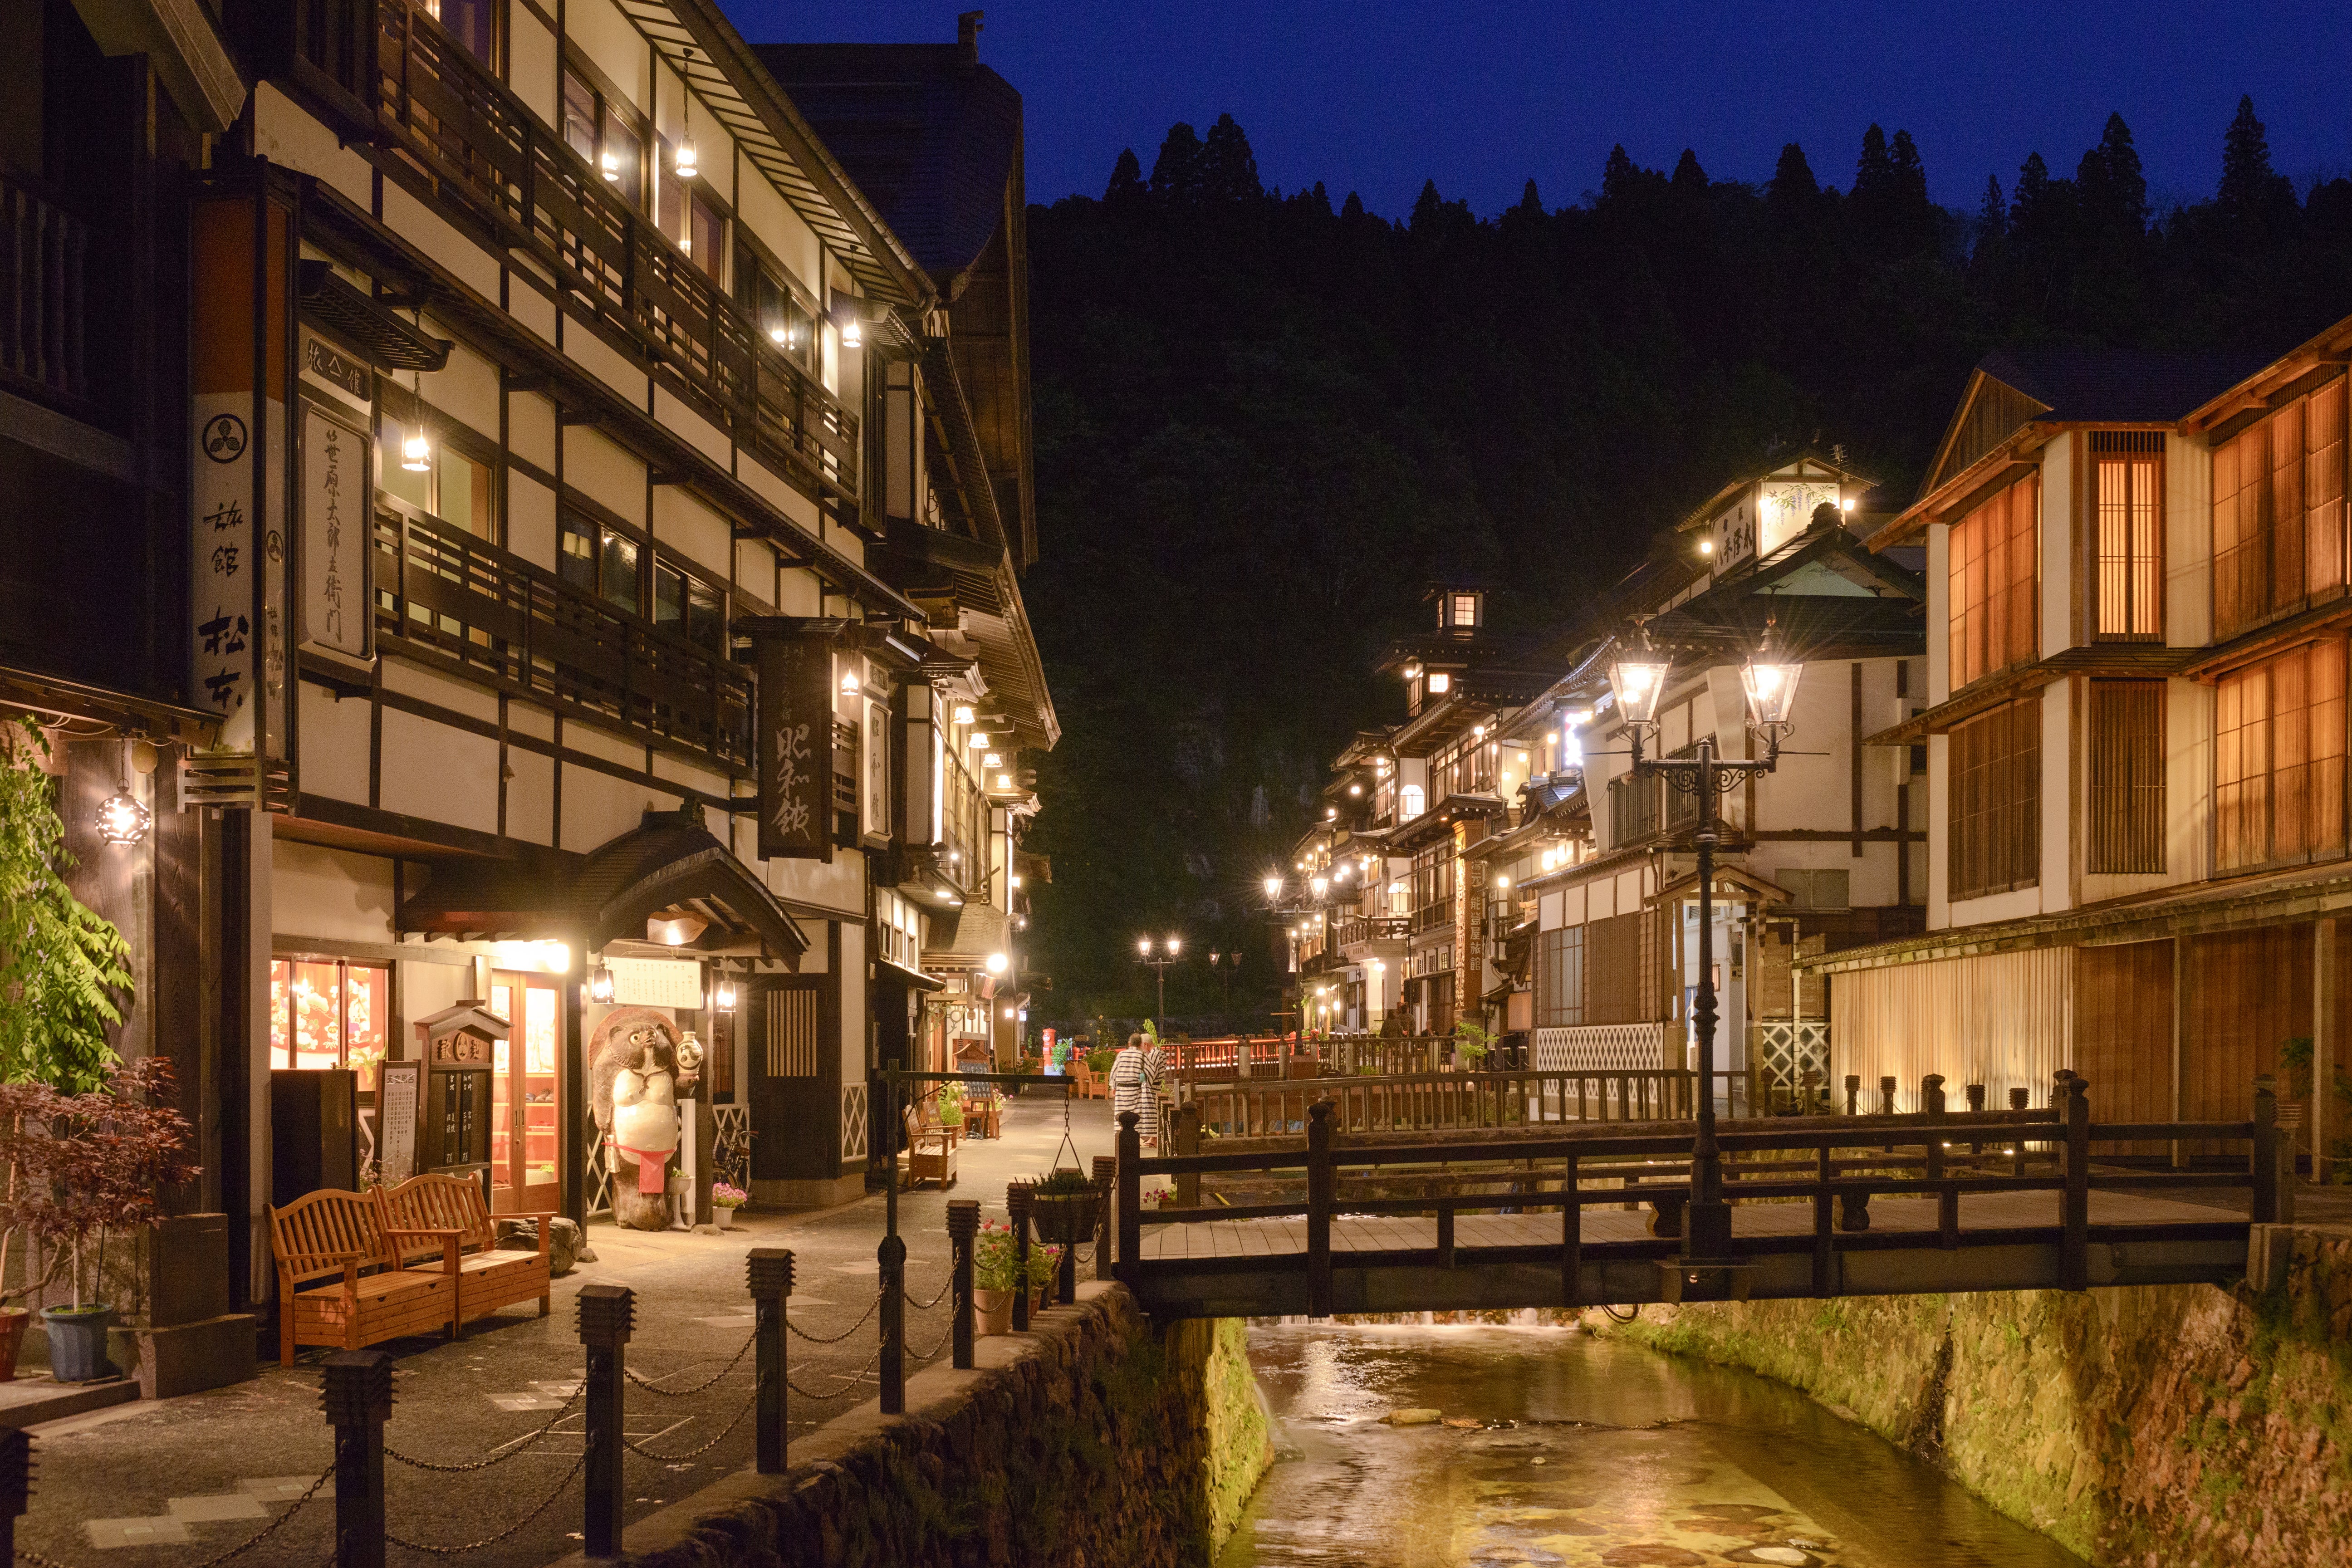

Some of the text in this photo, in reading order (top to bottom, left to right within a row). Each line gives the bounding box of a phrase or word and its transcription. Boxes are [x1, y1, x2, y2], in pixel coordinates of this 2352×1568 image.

[1470, 897, 1482, 971] 能登屋旅館
[387, 1074, 414, 1084] 天空風呂
